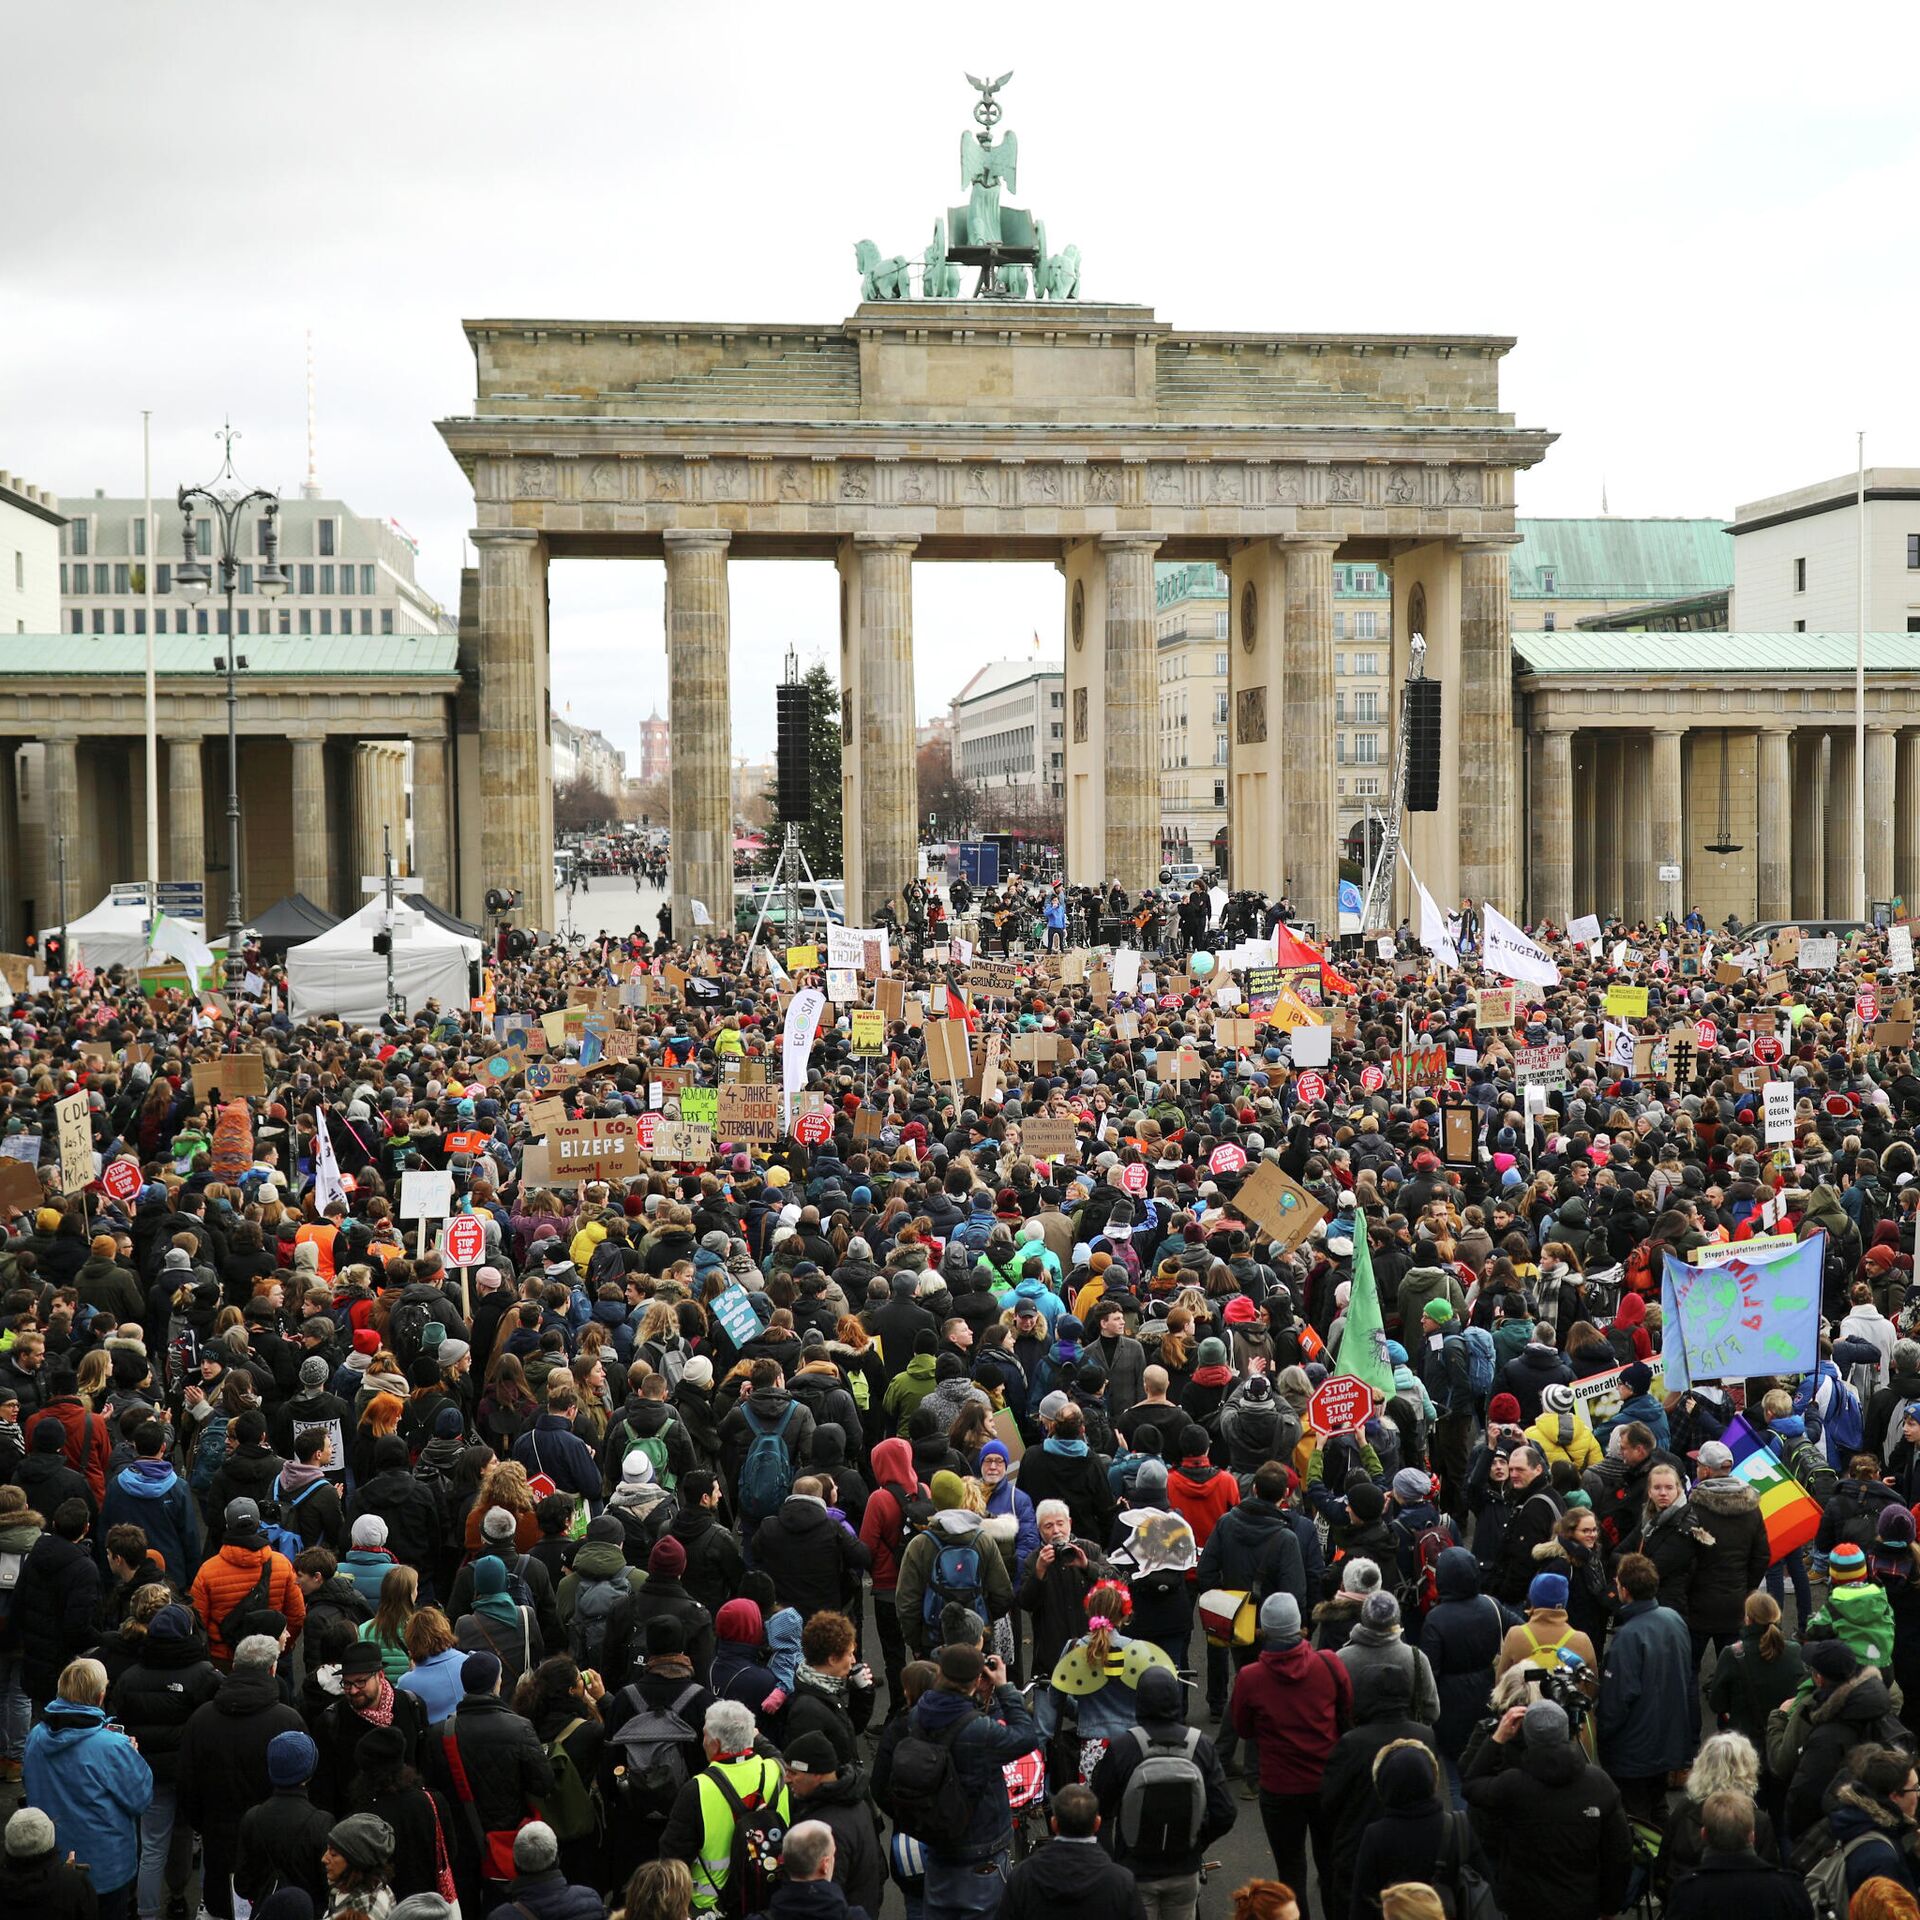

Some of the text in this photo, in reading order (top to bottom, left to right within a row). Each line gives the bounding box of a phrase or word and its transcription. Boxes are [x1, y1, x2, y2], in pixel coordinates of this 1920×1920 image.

[1503, 940, 1551, 963] JUGEND
[1516, 1058, 1531, 1066] MAKE
[1531, 1062, 1549, 1070] PLACE
[1517, 1073, 1528, 1081] FOR
[1556, 1068, 1564, 1076] ME
[725, 1086, 737, 1103] 4
[739, 1085, 773, 1103] JAHRE
[1769, 1095, 1789, 1104] OMAS
[63, 1099, 89, 1123] CDU
[719, 1103, 777, 1119] NACH BIENEN
[1768, 1107, 1790, 1116] GEGEN
[806, 1116, 824, 1125] STOP
[1768, 1119, 1793, 1128] RECHTS
[555, 1127, 579, 1136] Von
[642, 1130, 655, 1138] STO
[687, 1124, 710, 1134] THINK
[718, 1119, 756, 1138] STERBEN
[756, 1122, 775, 1139] WIR
[804, 1129, 822, 1138] STOP
[64, 1137, 77, 1148] das
[560, 1138, 625, 1158] BIZEPS
[1216, 1147, 1234, 1158] STOP
[109, 1163, 127, 1176] STOP
[608, 1161, 623, 1170] der
[1221, 1160, 1239, 1172] STOP
[115, 1176, 132, 1188] STOP
[457, 1221, 475, 1230] STOP
[457, 1239, 475, 1247] STOP
[1704, 1250, 1725, 1259] Steppt
[1325, 1381, 1354, 1397] STOP
[1320, 1391, 1359, 1405] Klimakrise
[1326, 1402, 1355, 1416] STOP
[1328, 1413, 1354, 1424] GroKo
